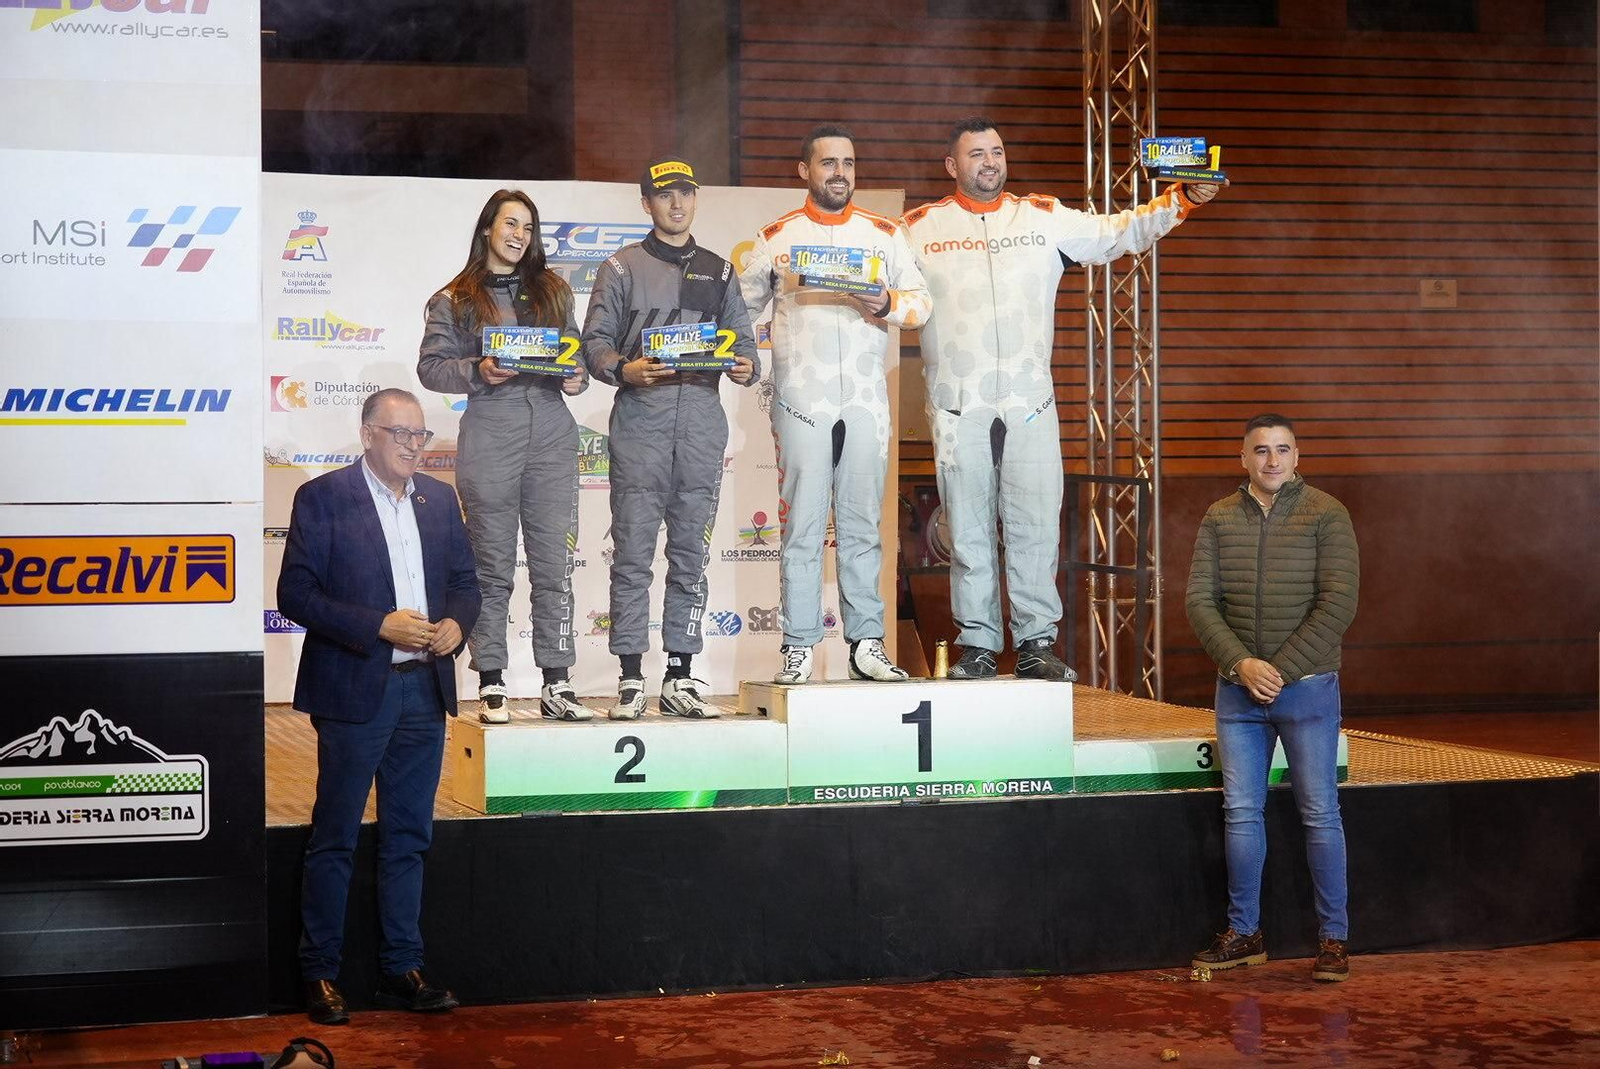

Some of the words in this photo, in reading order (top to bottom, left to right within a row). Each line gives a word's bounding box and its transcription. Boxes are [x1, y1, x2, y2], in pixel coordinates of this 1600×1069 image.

[51, 21, 229, 39] www.rallycar.es
[1160, 144, 1193, 155] RALLYE
[1208, 145, 1221, 171] 1
[33, 218, 106, 248] MSi
[32, 252, 106, 266] Institute
[810, 253, 849, 264] RALLYE
[287, 279, 317, 287] Española
[317, 279, 327, 287] de
[297, 270, 333, 279] Federación
[282, 287, 332, 295] Automovilismo
[277, 317, 386, 342] Rallycar
[664, 330, 702, 345] RALLYE
[504, 335, 544, 346] RALLYE
[713, 329, 738, 358] 2
[555, 336, 581, 366] 2
[314, 381, 380, 394] Diputación
[1, 388, 232, 413] MICHELIN
[314, 395, 328, 406] de
[793, 410, 816, 428] CASAL
[721, 550, 739, 558] LOS
[901, 700, 933, 773] 1
[614, 735, 647, 785] 2
[1196, 743, 1214, 770] 3
[814, 786, 910, 800] ESCUDERIA
[915, 783, 977, 797] SIERRA
[982, 780, 1053, 794] MORENA
